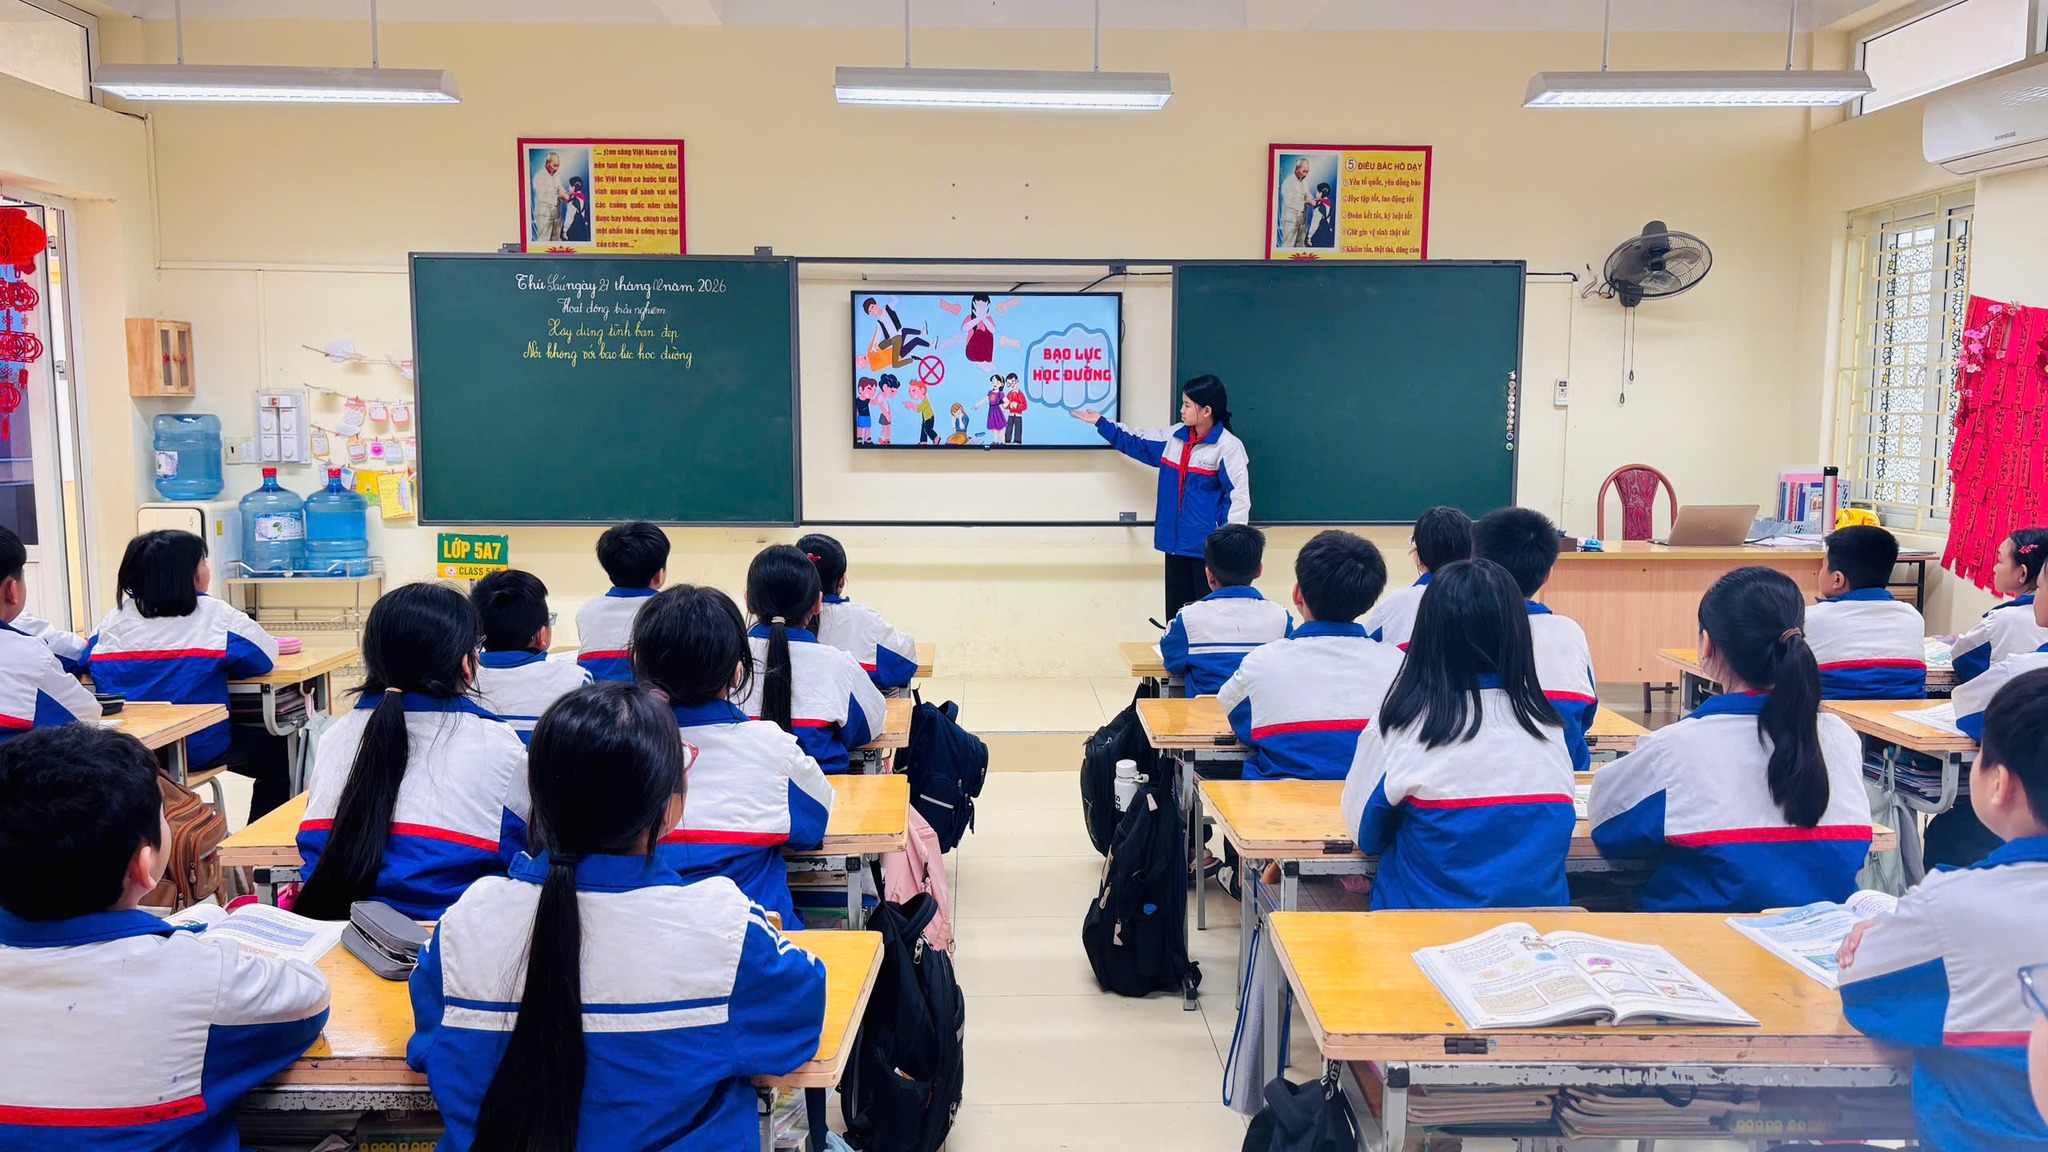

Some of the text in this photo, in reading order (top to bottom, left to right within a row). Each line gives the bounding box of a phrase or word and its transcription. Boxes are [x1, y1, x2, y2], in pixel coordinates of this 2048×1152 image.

[1348, 159, 1354, 170] 5
[1377, 161, 1392, 170] BÁC
[1407, 162, 1422, 172] DẠY
[565, 280, 597, 299] ngày
[614, 275, 652, 299] tháng
[663, 282, 695, 292] năm
[698, 278, 727, 293] 2026
[1044, 347, 1102, 364] BẠO LỰC
[1033, 369, 1060, 384] HỌC
[444, 537, 502, 560] LỚP 5A7
[459, 566, 484, 575] CLASS
